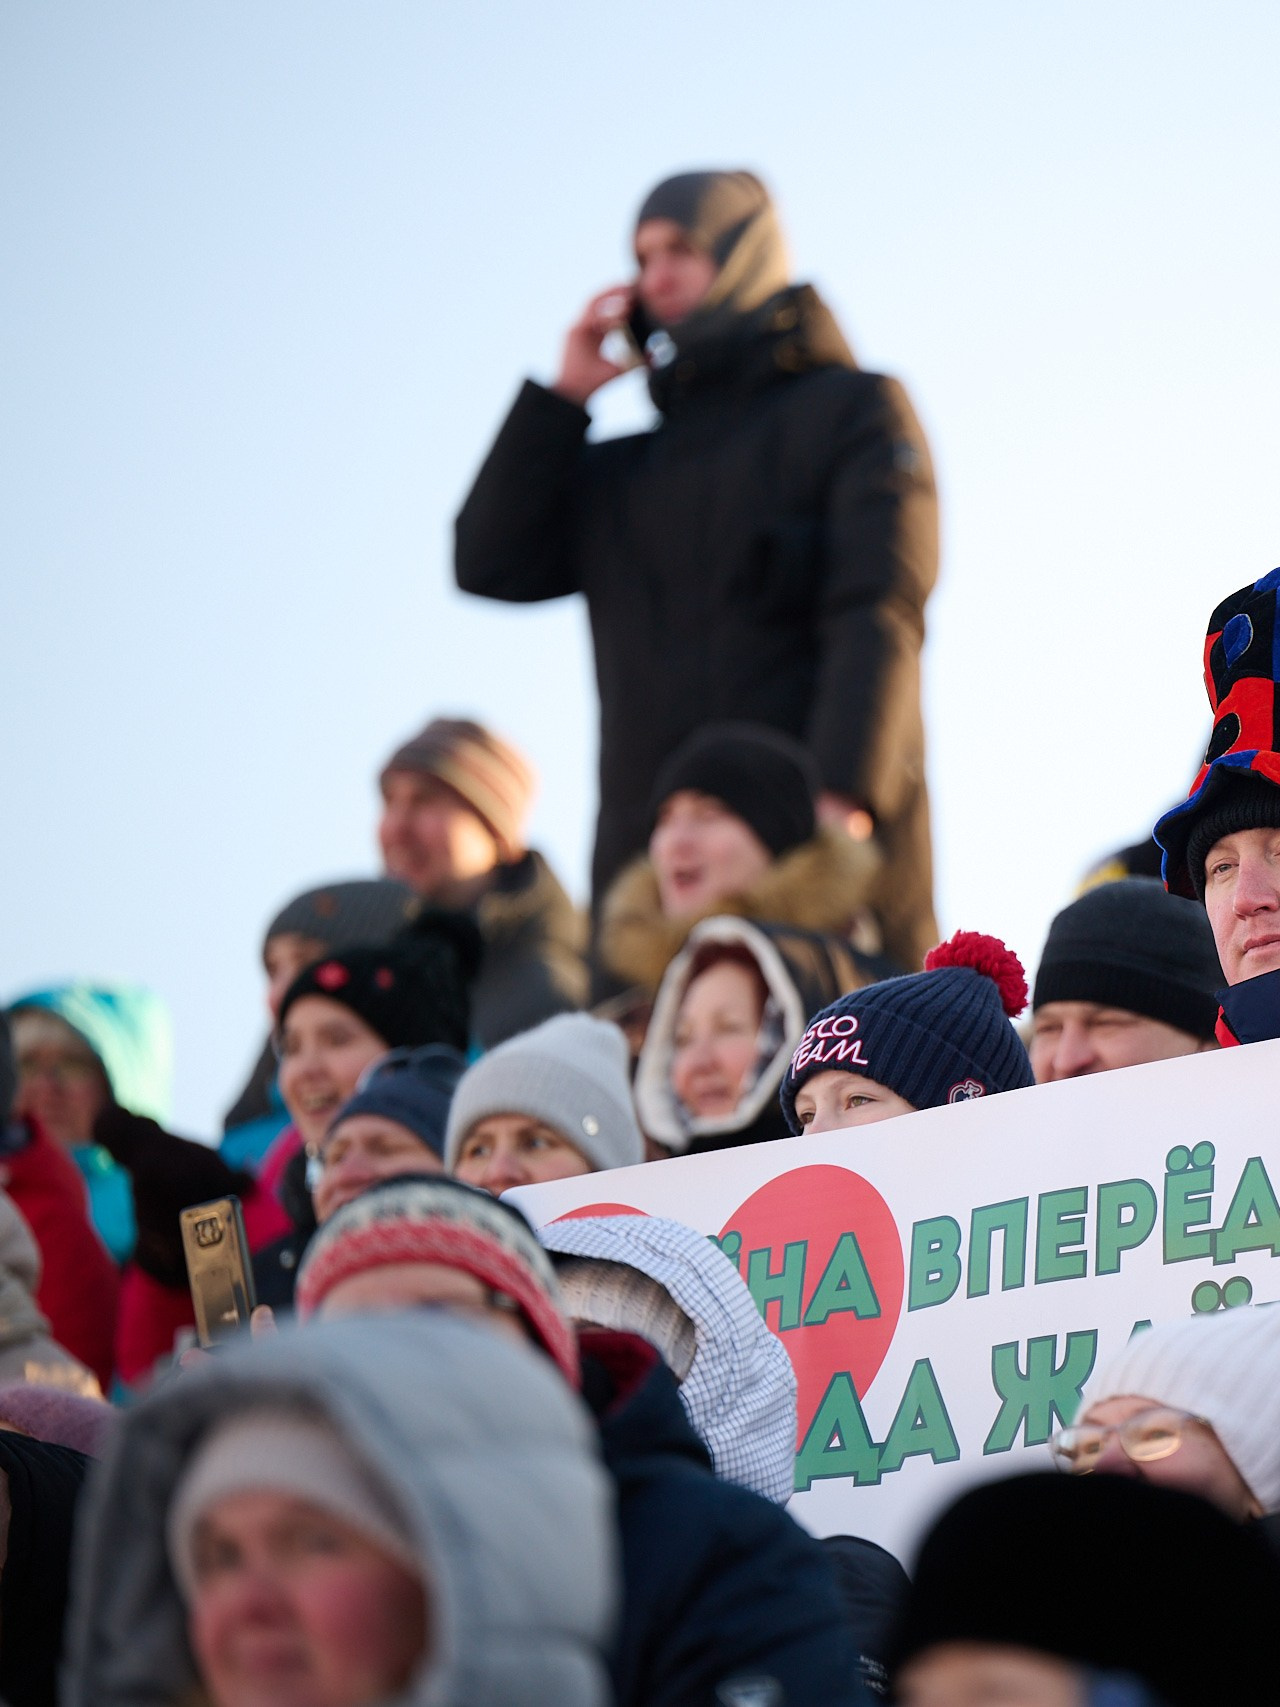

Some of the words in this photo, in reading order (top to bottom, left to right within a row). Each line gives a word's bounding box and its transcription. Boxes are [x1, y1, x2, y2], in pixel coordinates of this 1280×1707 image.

[797, 1014, 859, 1050] SCO
[790, 1039, 869, 1080] TEAM
[793, 1357, 961, 1491] ДА
